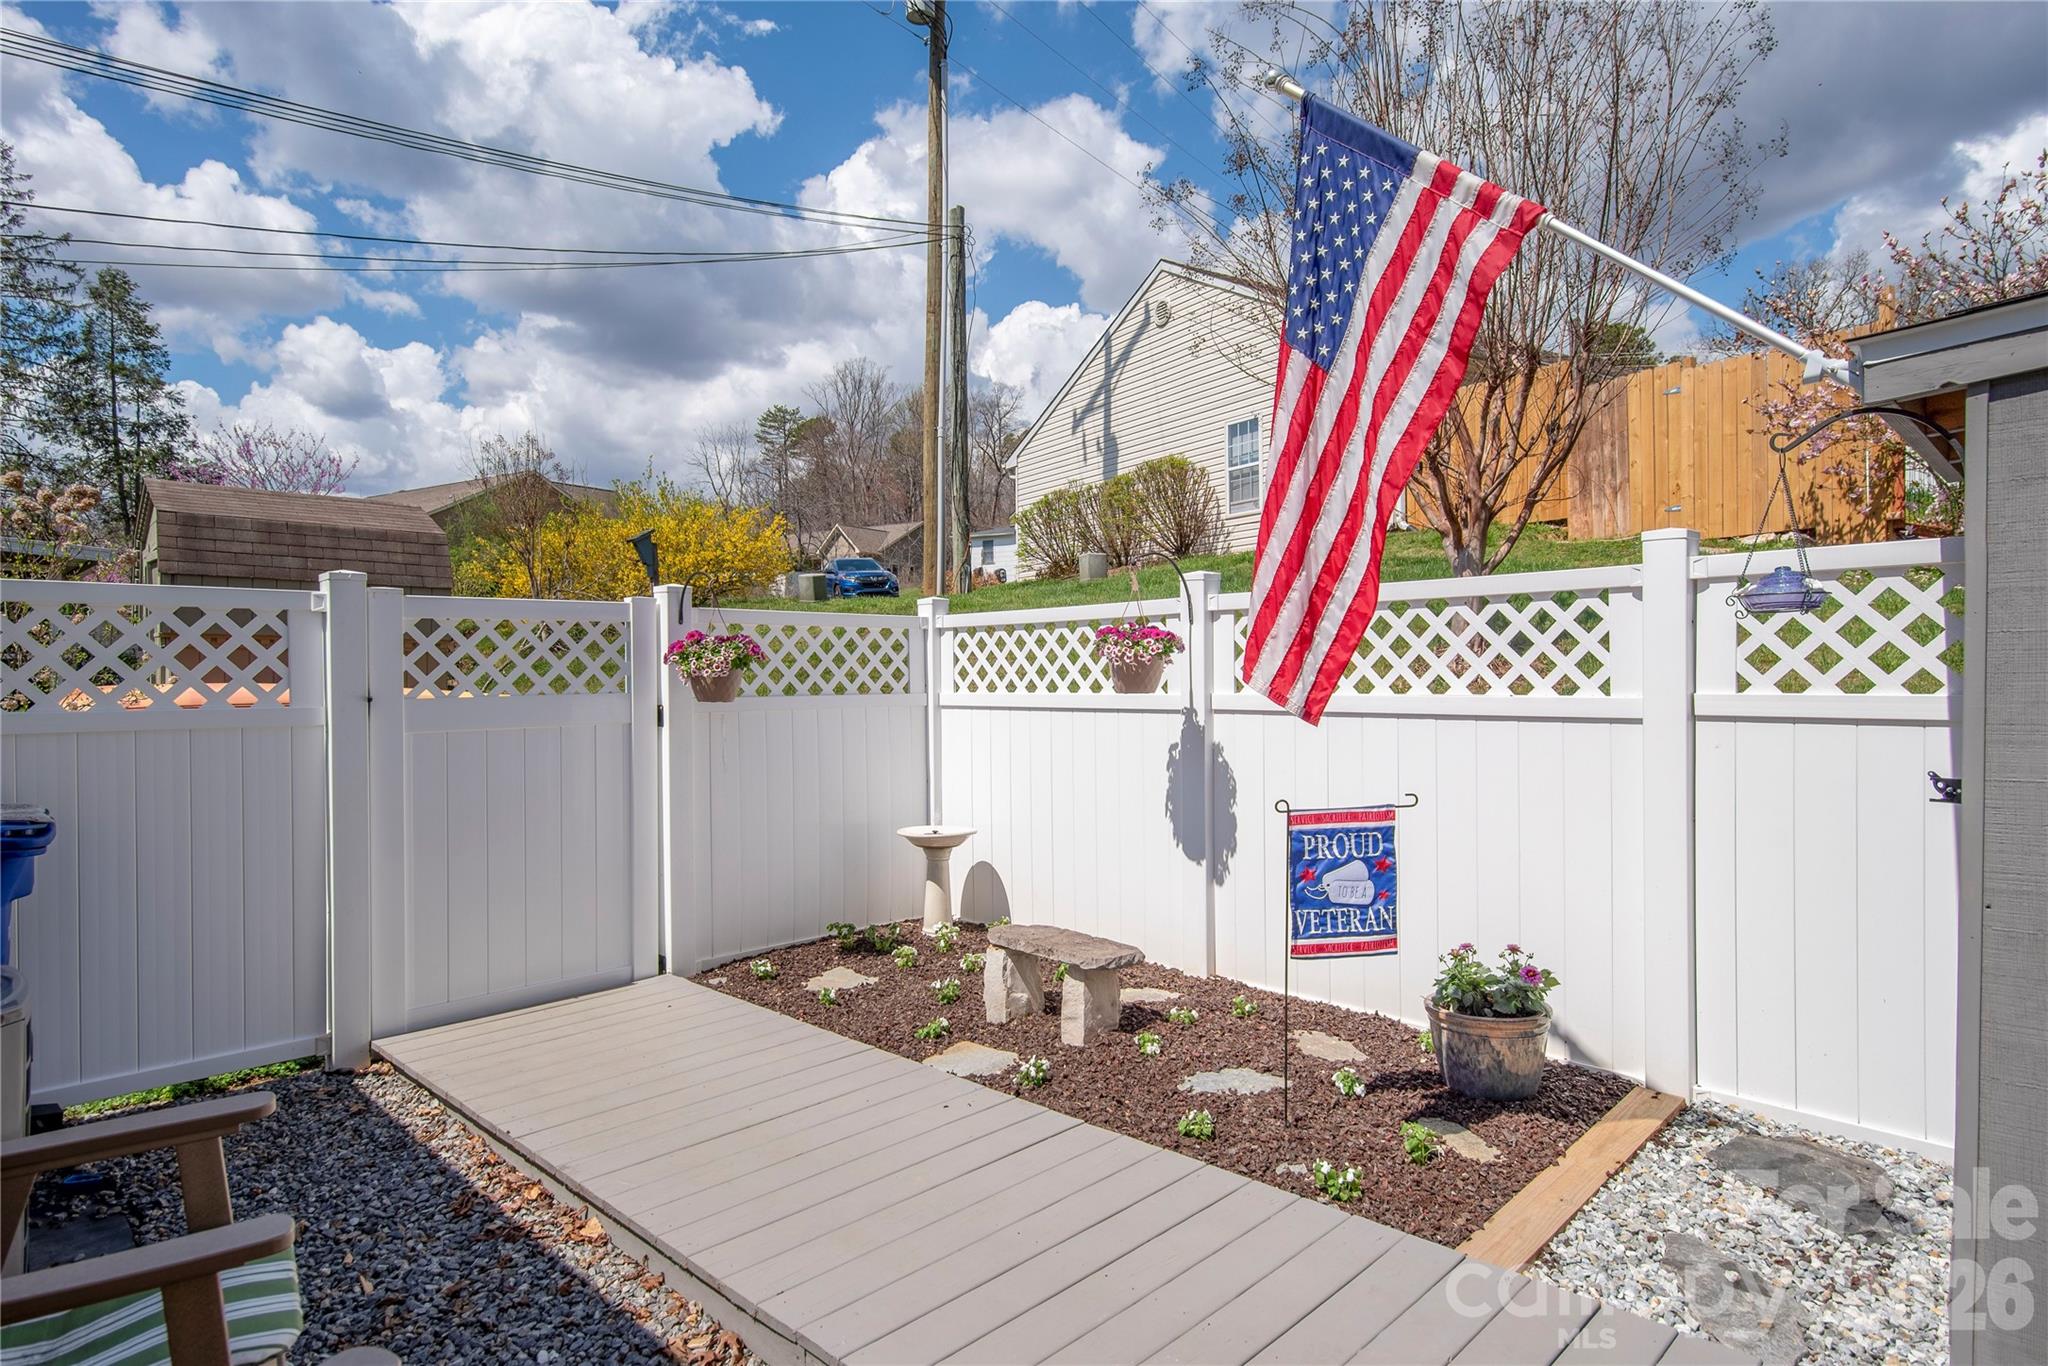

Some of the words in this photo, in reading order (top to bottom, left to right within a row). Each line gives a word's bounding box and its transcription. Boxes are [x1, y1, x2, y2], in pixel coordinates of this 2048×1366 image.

[1302, 832, 1384, 860] PROUD
[1338, 885, 1348, 898] TO
[1351, 885, 1359, 899] BE
[1361, 886, 1367, 898] A
[1294, 905, 1395, 935] VETERAN
